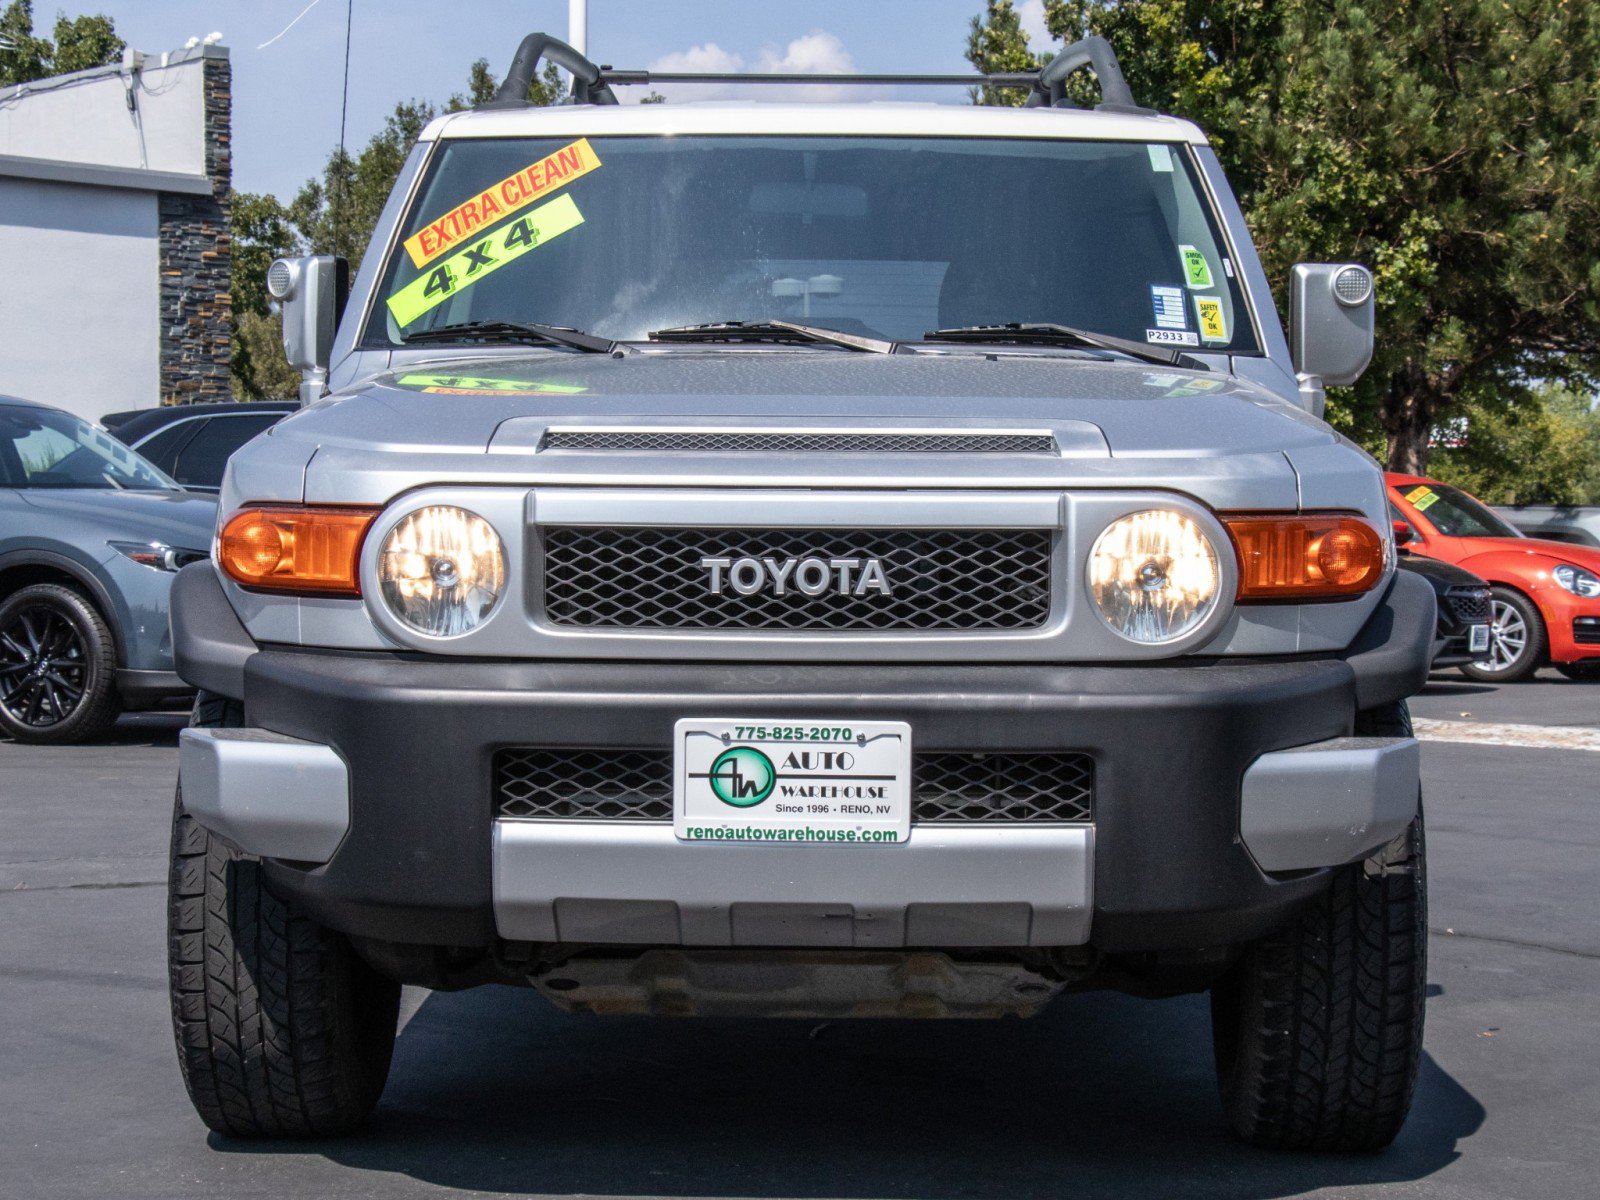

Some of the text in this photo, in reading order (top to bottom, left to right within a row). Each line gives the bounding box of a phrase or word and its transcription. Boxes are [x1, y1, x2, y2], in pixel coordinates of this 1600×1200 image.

[418, 146, 584, 258] EXTRA CLEAN
[423, 264, 457, 299] 4
[504, 217, 540, 250] 4
[1200, 303, 1218, 311] SAFETY
[1148, 331, 1183, 341] P2933
[701, 558, 892, 596] TOYOTA
[735, 726, 853, 741] 775-825-2070
[781, 751, 855, 771] AUTO
[780, 785, 889, 799] WAREHOUSE
[775, 803, 891, 816] Since 1996 RENO, NV
[686, 826, 899, 842] renoautowarehouse.com
